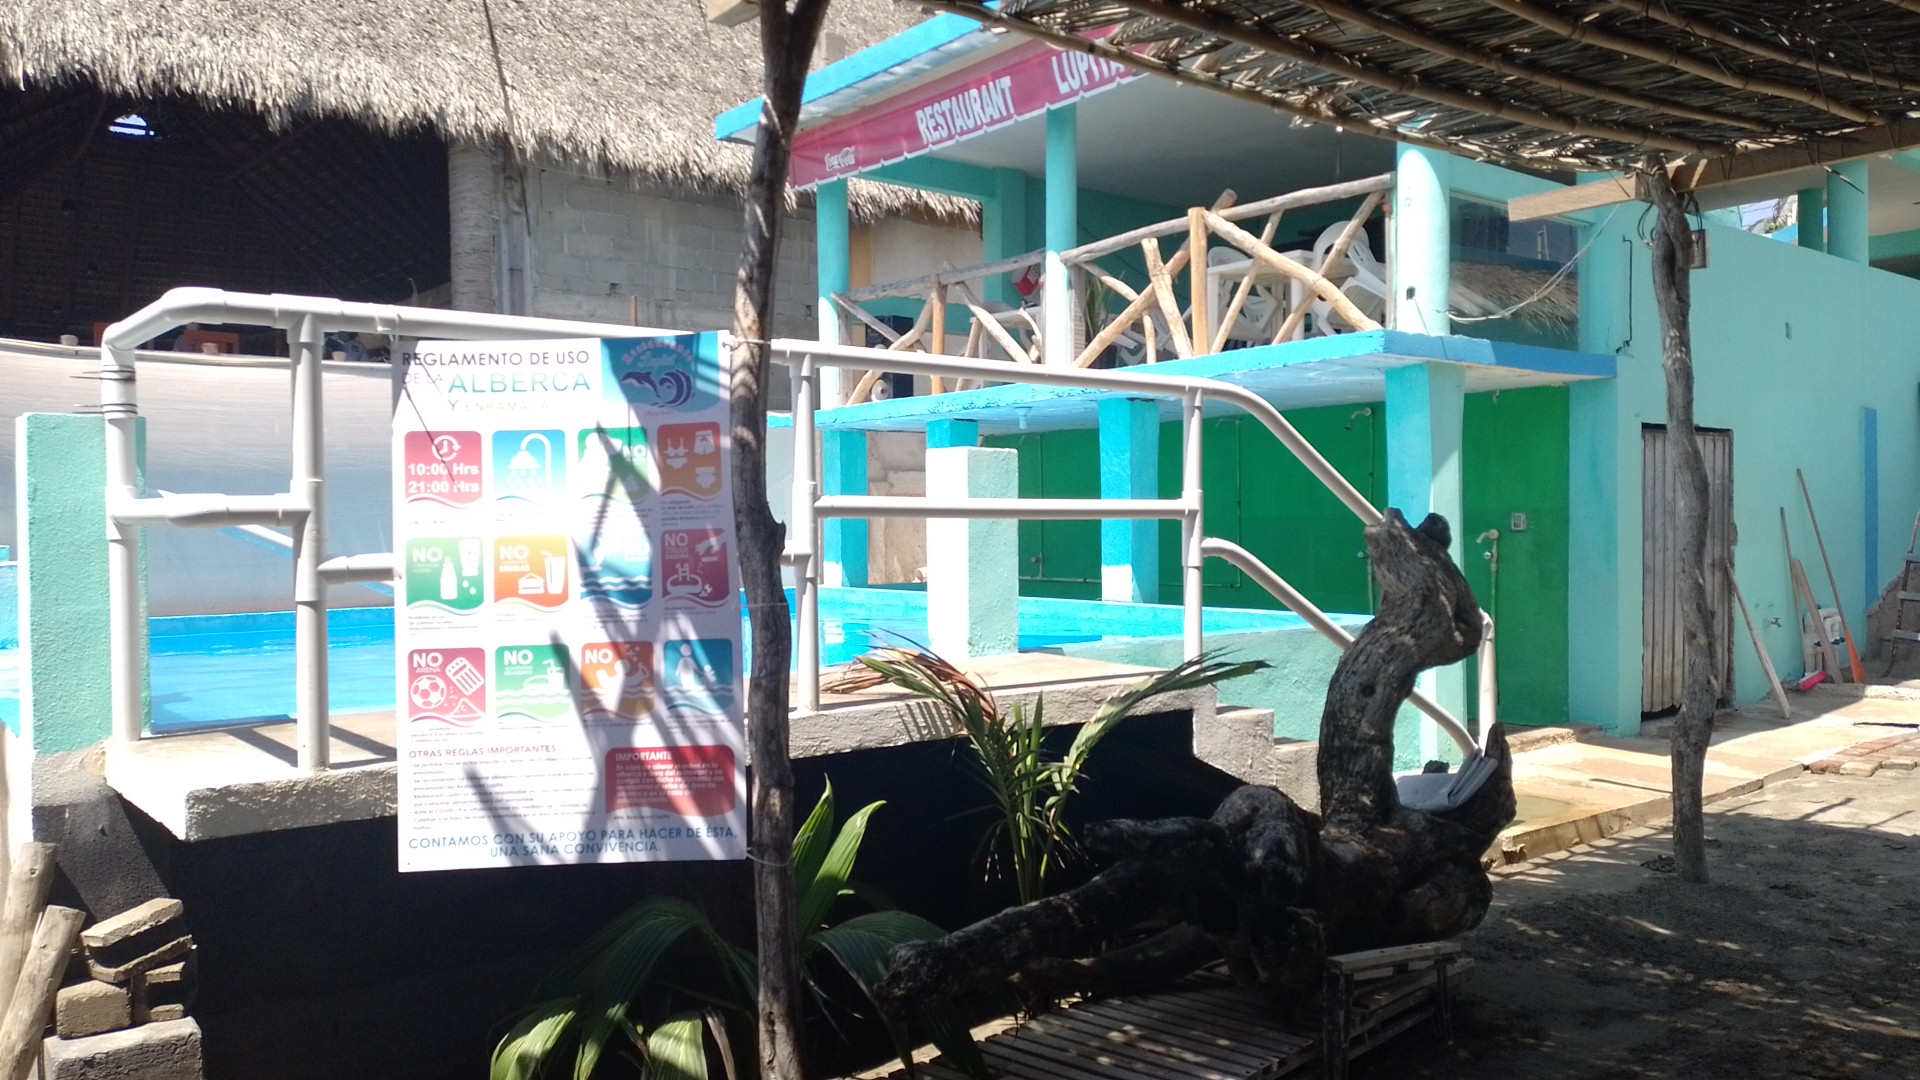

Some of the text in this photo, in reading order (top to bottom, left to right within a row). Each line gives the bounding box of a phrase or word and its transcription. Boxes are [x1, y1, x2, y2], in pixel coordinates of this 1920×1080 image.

[915, 76, 1015, 144] RESTAURANT
[402, 350, 590, 366] REGLAMENTO DE USO
[402, 372, 421, 385] DE
[448, 371, 591, 394] ALBERCA
[448, 400, 459, 412] Y
[408, 463, 479, 476] 10:00 Hrs
[408, 481, 480, 494] 21:00 Hrs
[664, 532, 688, 546] NO
[412, 546, 443, 562] NO
[498, 544, 529, 560] NO
[413, 652, 443, 668] NO
[504, 649, 534, 666] NO
[584, 648, 614, 664] NO
[408, 744, 556, 758] OTRAS REGLAS IMPORTANTES
[616, 752, 672, 761] IMPORTANTE
[408, 834, 488, 849] CONTAMOS
[493, 833, 524, 845] CON
[529, 832, 544, 844] SU
[549, 830, 597, 842] APOYO
[600, 828, 634, 840] PARA
[640, 828, 682, 839] HACER
[686, 827, 702, 838] DE
[490, 842, 662, 858] UNA SANA CONVIVENCIA.
